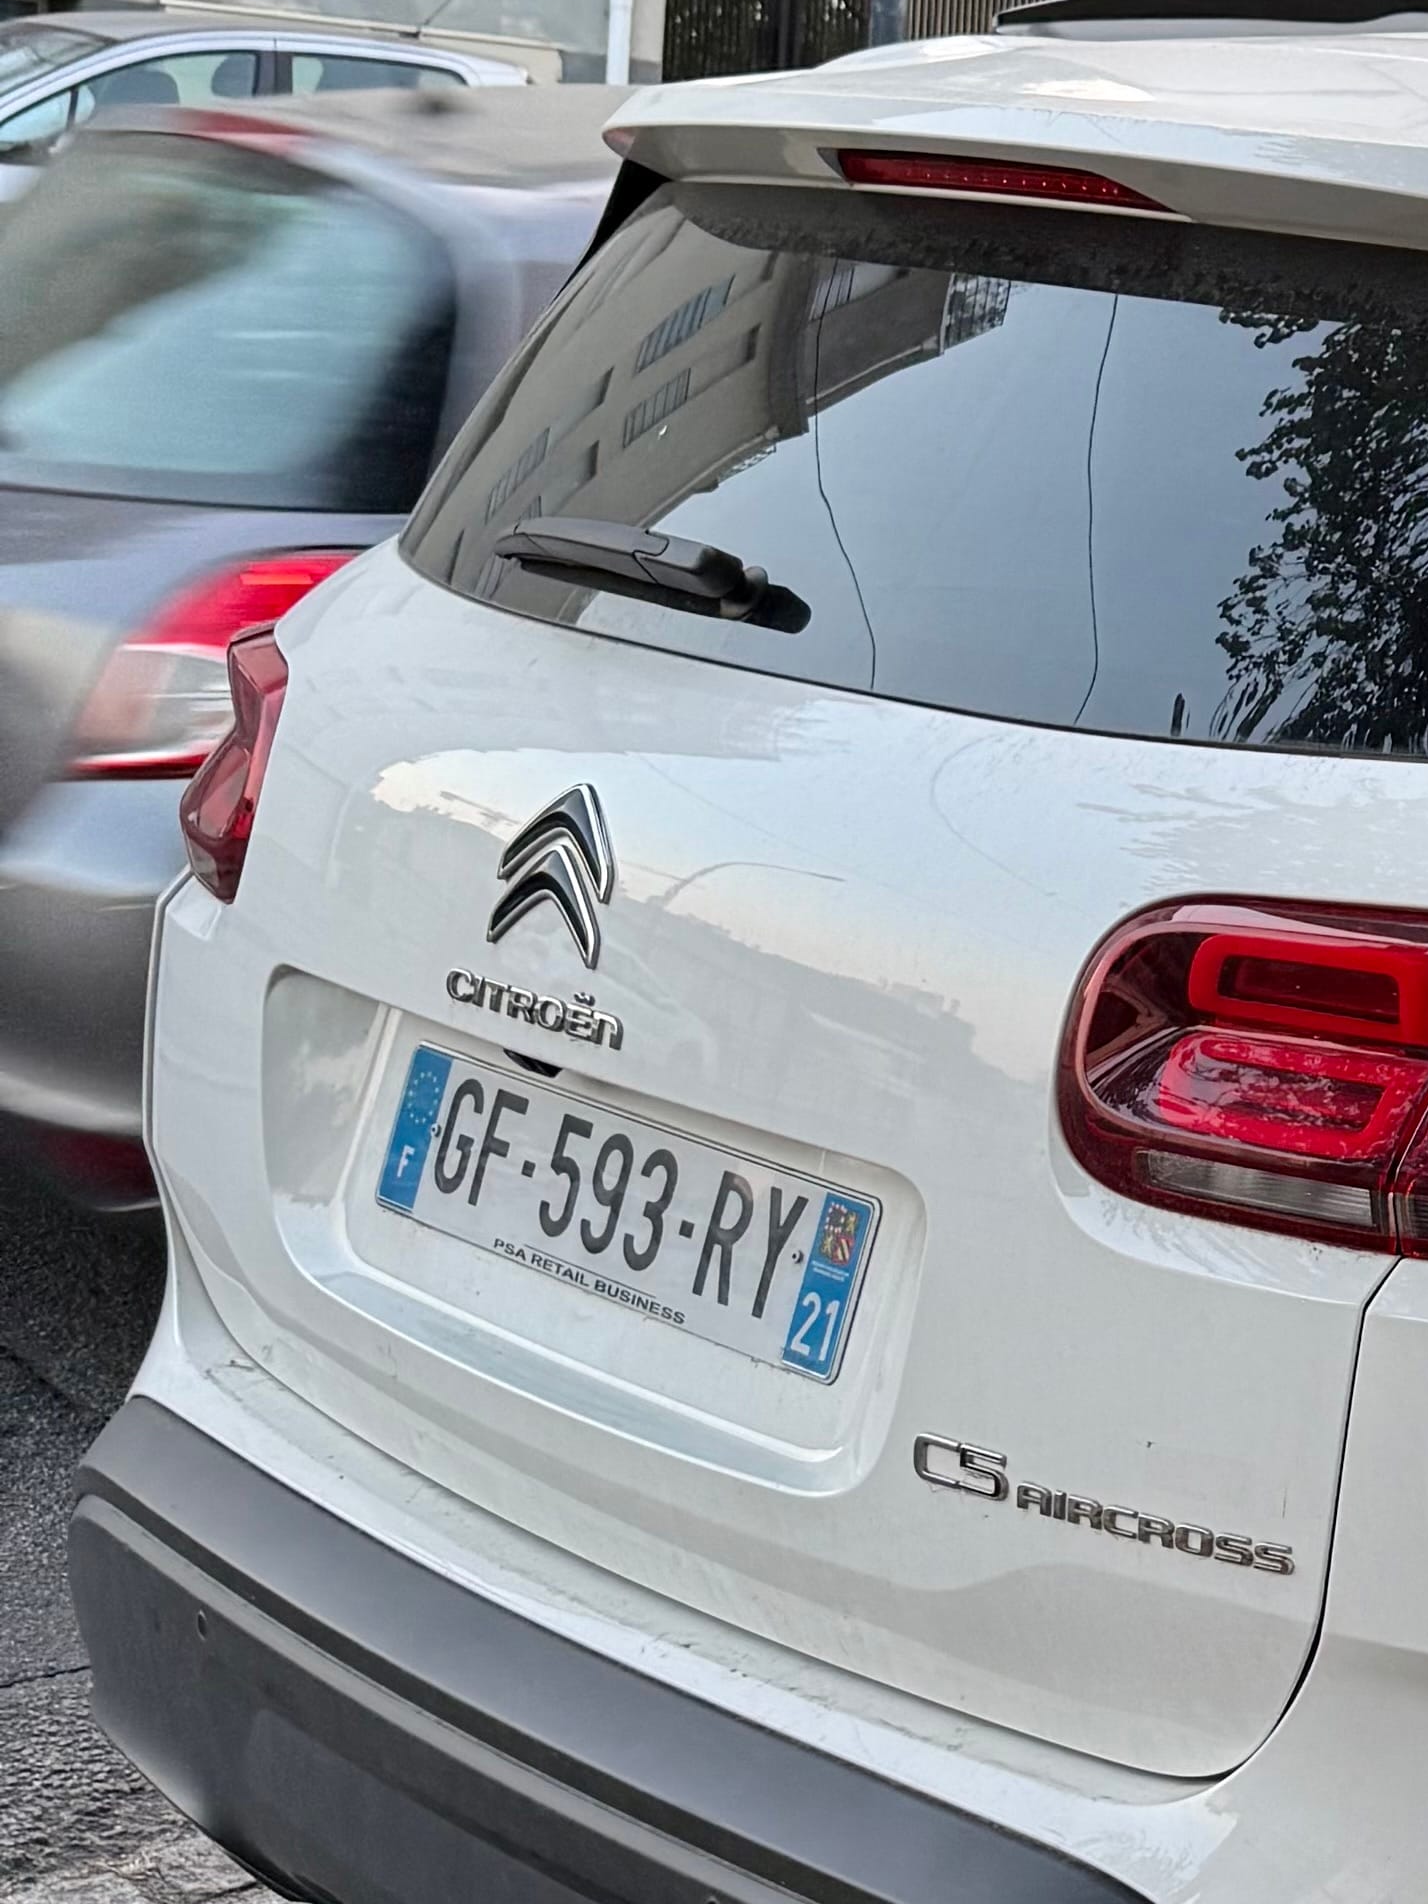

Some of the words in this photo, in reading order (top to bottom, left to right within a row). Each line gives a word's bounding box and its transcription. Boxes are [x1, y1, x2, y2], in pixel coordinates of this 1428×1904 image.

[446, 967, 625, 1051] CITROËN
[396, 1144, 416, 1178] F
[434, 1078, 809, 1319] GF-593-RY
[493, 1238, 527, 1262] PSA
[530, 1253, 590, 1288] RETAIL
[593, 1278, 686, 1325] BUSINESS
[790, 1291, 841, 1362] 21
[913, 1431, 1010, 1502] C5
[1016, 1481, 1296, 1576] AIRCROSS
